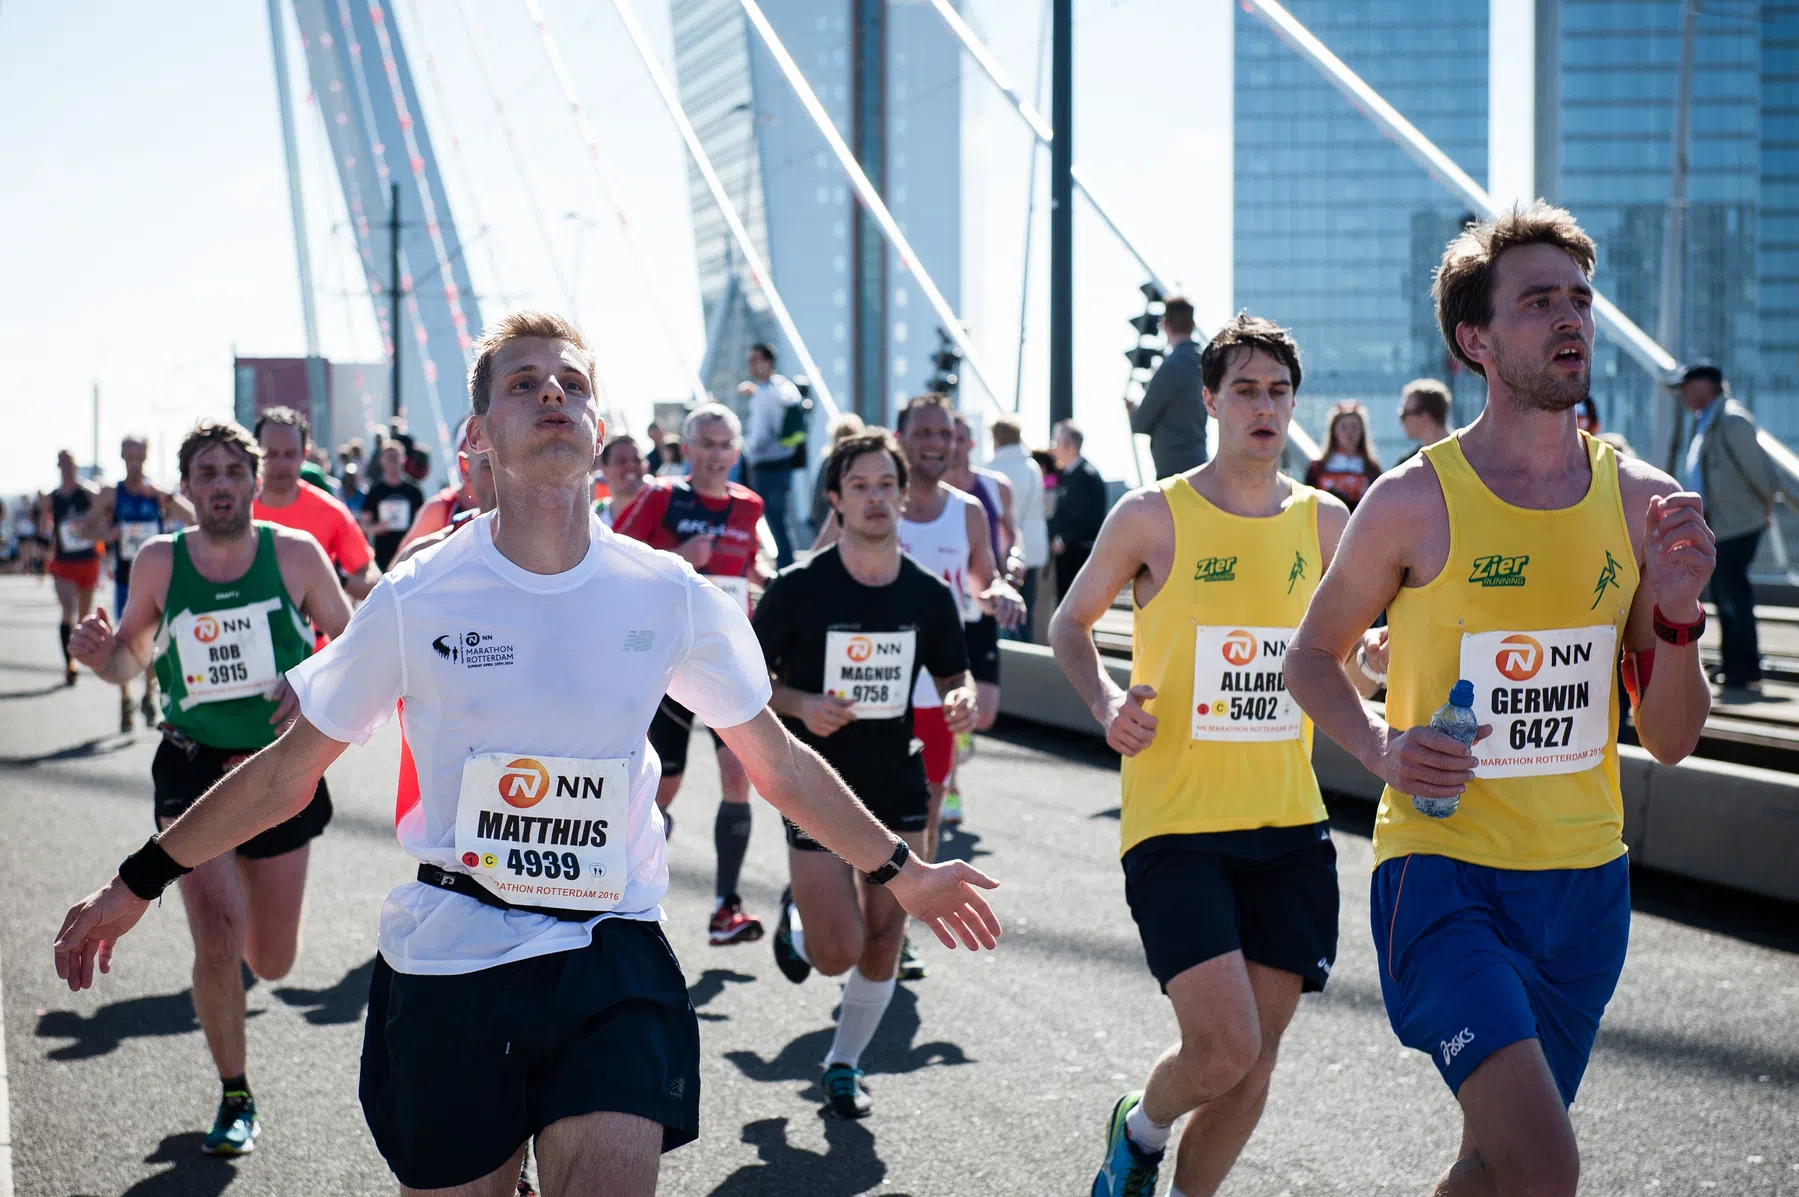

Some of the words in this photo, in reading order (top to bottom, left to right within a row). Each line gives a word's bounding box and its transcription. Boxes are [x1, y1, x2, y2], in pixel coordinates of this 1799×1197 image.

[1195, 556, 1237, 580] Zier
[1469, 555, 1529, 582] Zier
[1482, 577, 1525, 586] RUNNING
[223, 617, 251, 633] NN
[209, 644, 241, 662] ROB
[466, 645, 513, 655] MARATHON
[466, 653, 513, 663] ROTTERDAM
[877, 642, 902, 655] NN
[1550, 642, 1593, 667] NN
[208, 662, 248, 684] 3915
[841, 666, 902, 681] MAGNUS
[1220, 671, 1287, 692] ALLARD
[853, 685, 889, 703] 9758
[1491, 681, 1590, 715] GERWIN
[1230, 697, 1278, 721] 5402
[1208, 725, 1249, 733] MARATHON
[1509, 716, 1574, 750] 6427
[1480, 757, 1533, 766] MARATHON
[1535, 751, 1588, 764] ROTTERDAM
[556, 775, 604, 799] NN
[476, 810, 608, 848] MATTHIJS
[485, 855, 494, 865] C
[507, 848, 581, 881] 4939
[536, 886, 596, 898] ROTTERDAM
[597, 891, 620, 900] 2016
